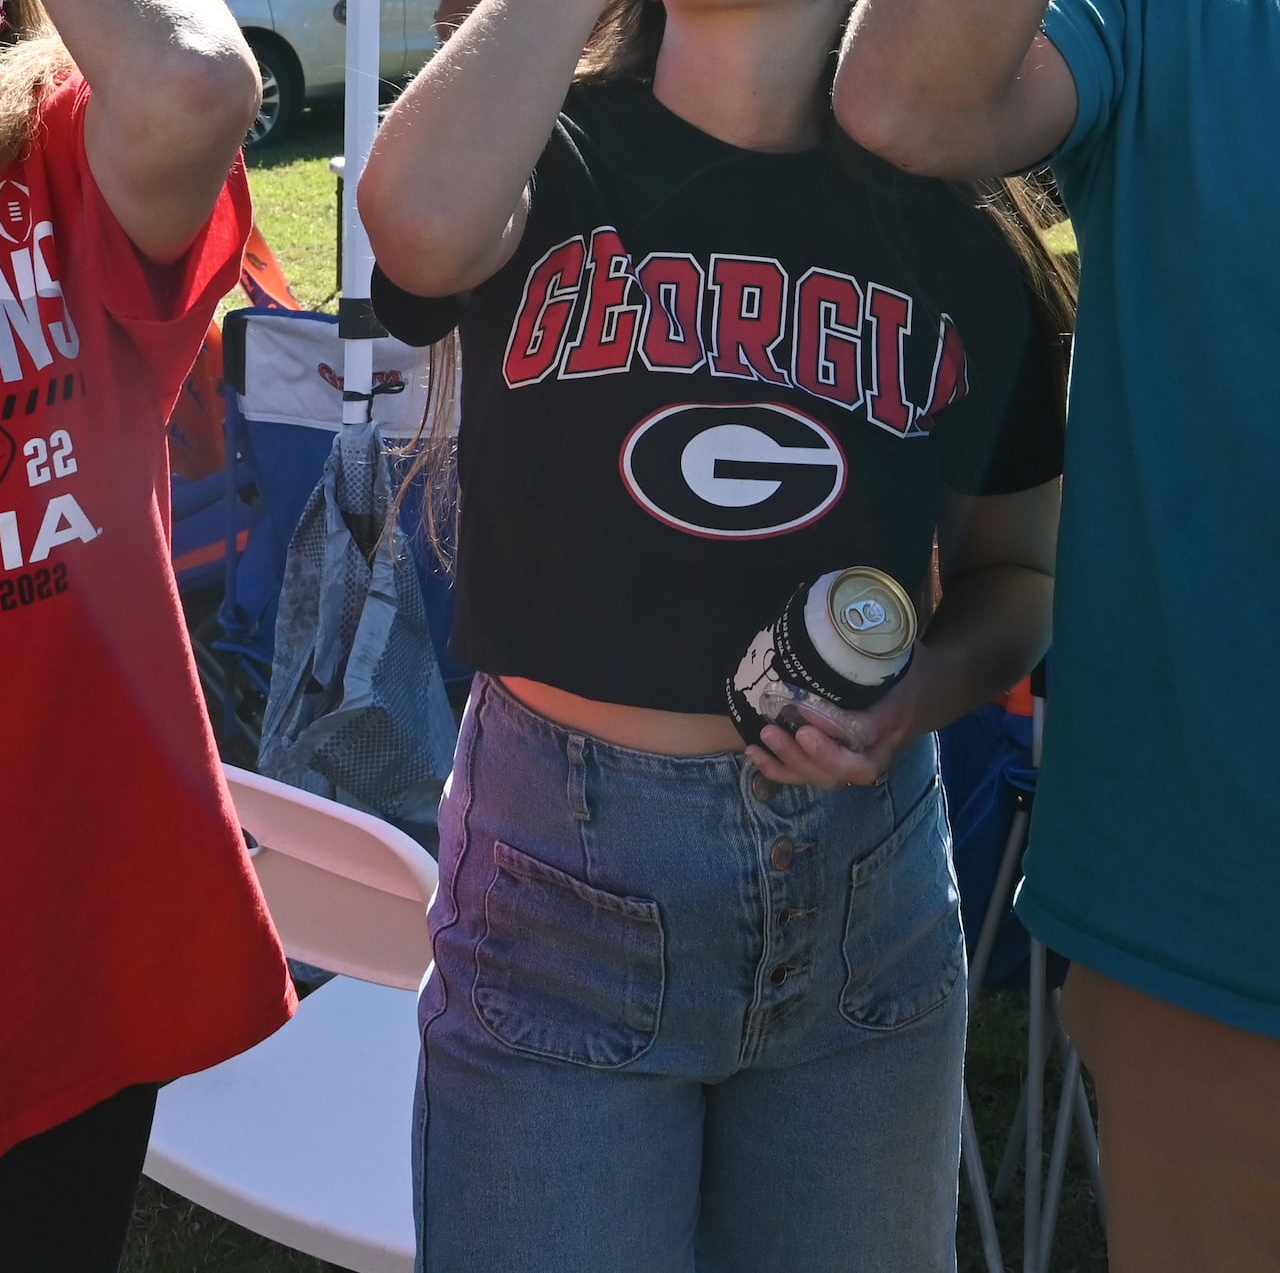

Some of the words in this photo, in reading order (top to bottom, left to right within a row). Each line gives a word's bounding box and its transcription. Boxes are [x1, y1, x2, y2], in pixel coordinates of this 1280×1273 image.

[22, 429, 78, 487] 22
[790, 652, 813, 684] NOTRE
[812, 681, 842, 702] DAME
